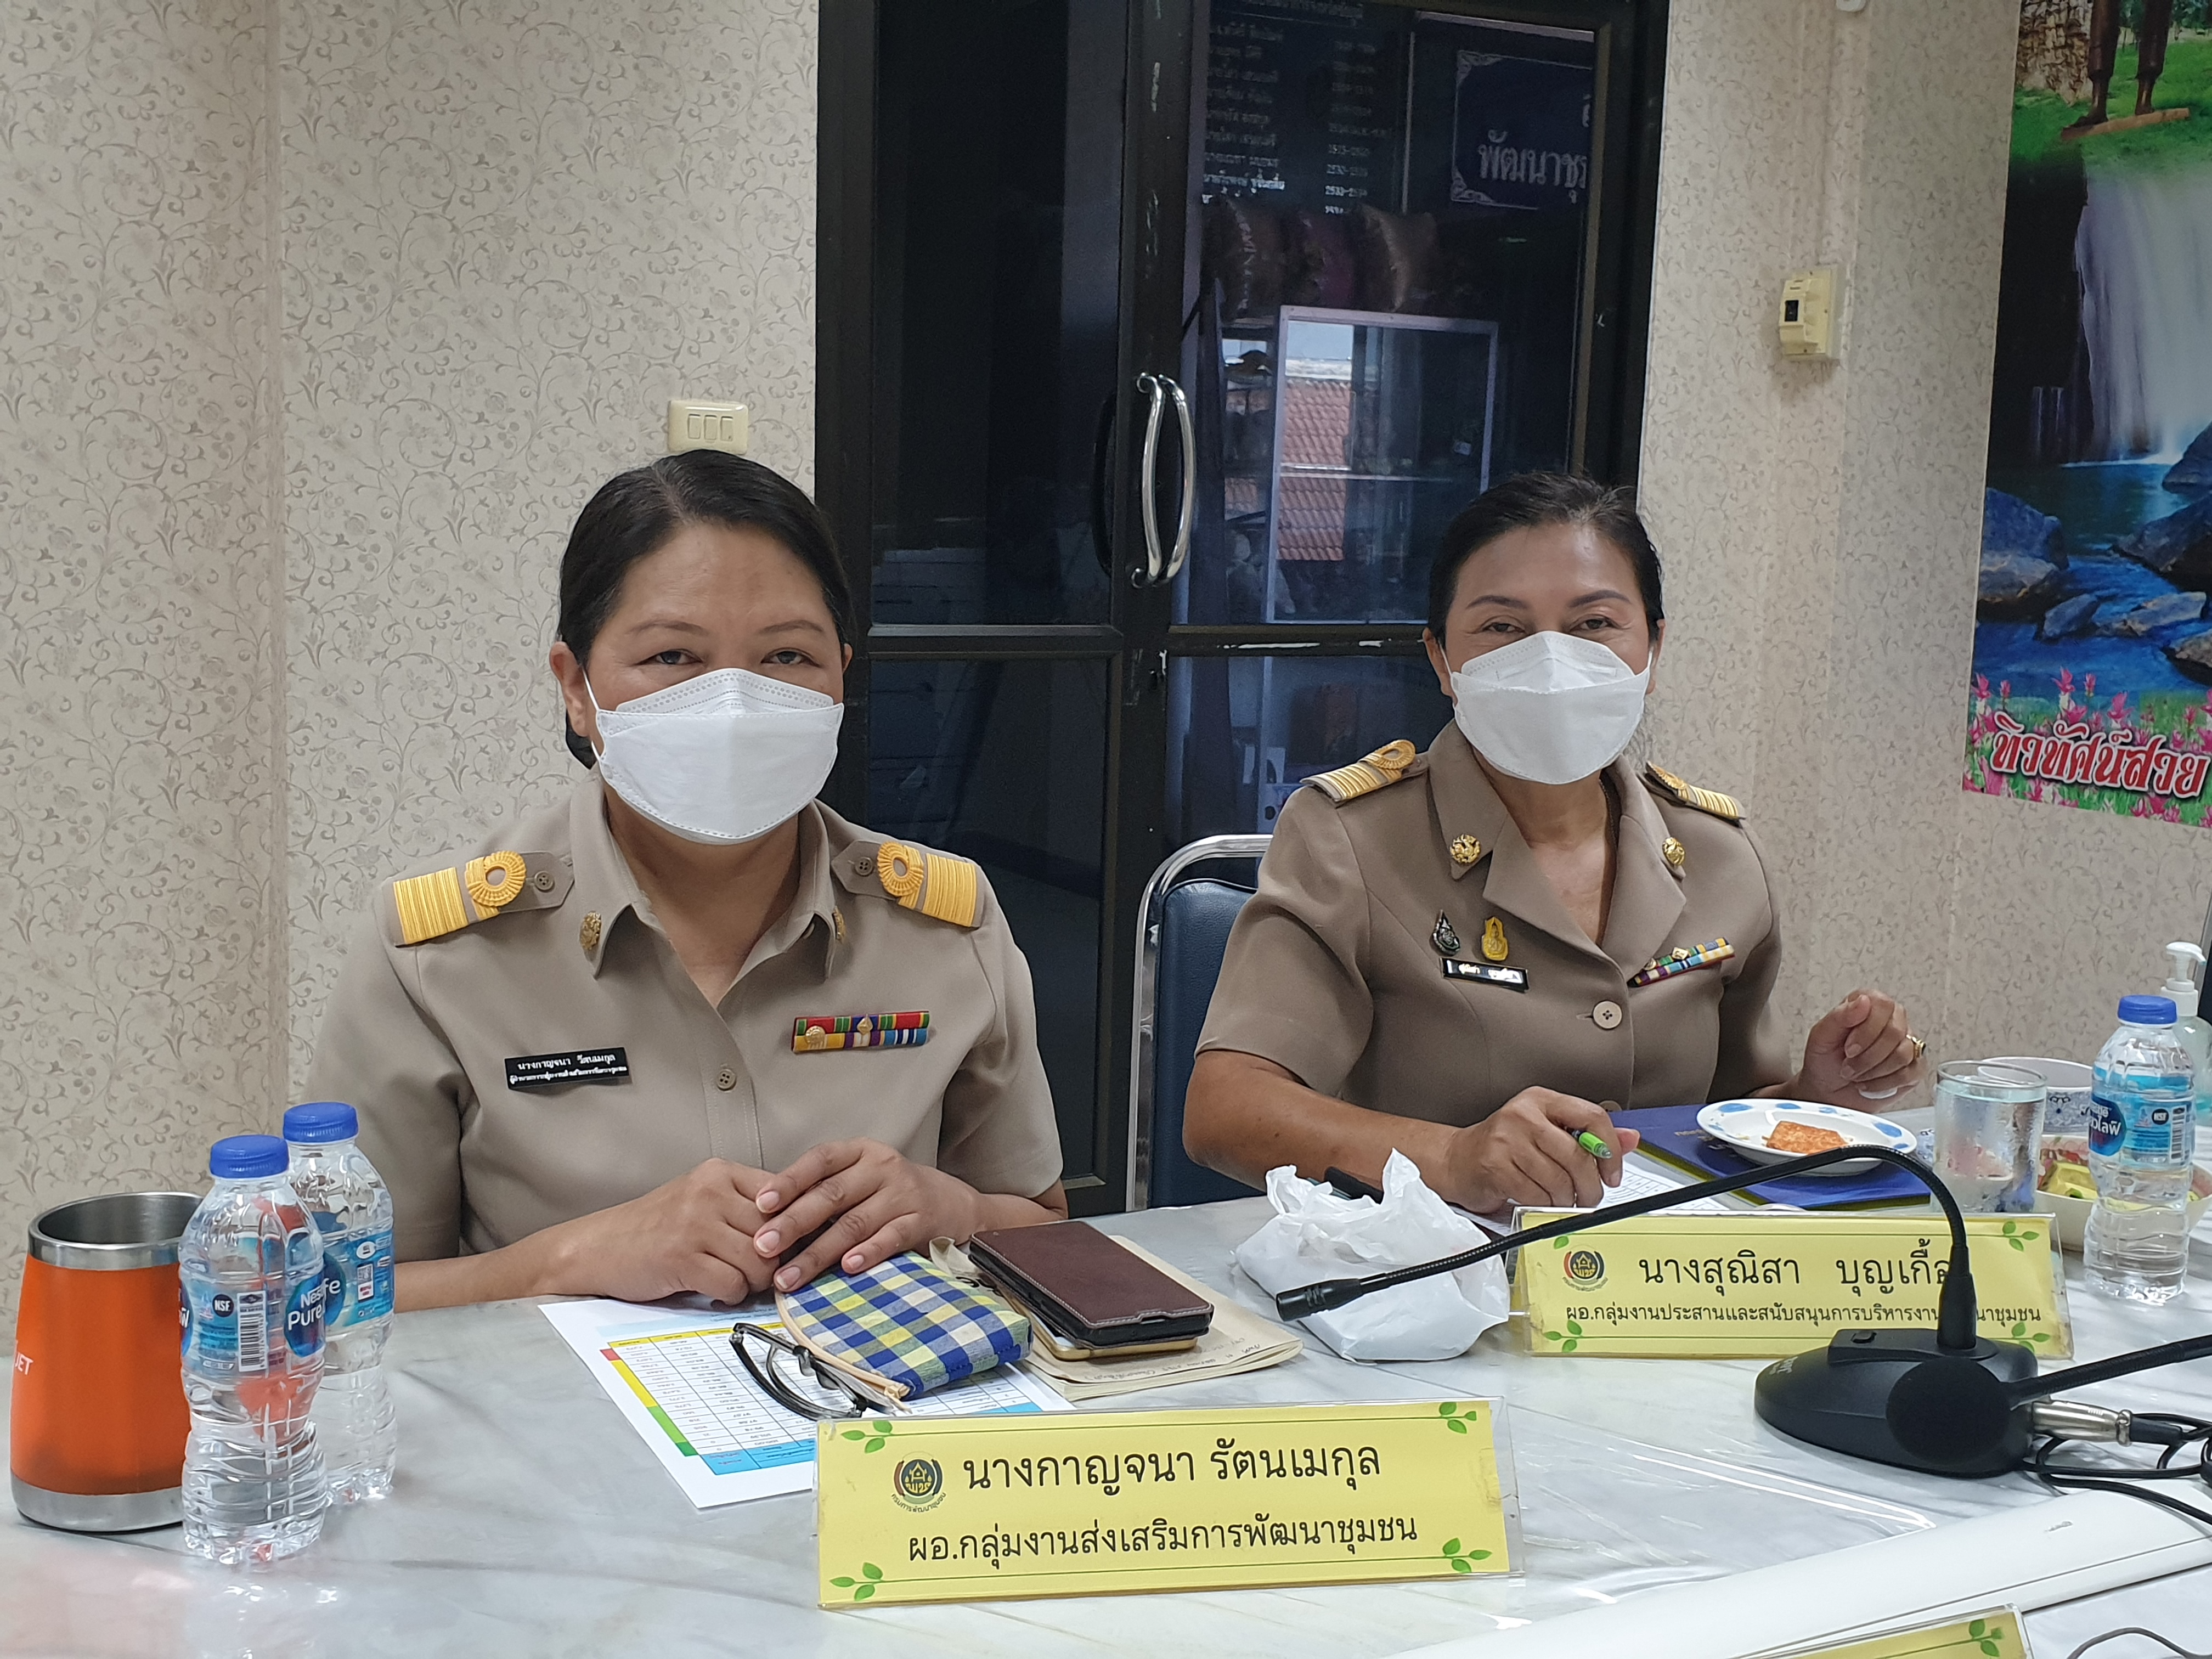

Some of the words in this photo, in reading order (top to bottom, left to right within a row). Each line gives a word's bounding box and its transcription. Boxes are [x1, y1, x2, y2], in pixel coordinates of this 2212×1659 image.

[1989, 712, 2210, 797] ทิวทัศน์สวย
[1638, 1249, 1800, 1297] นางสุณิสา
[214, 1300, 231, 1312] NSF
[963, 1451, 1194, 1496] นางกาญจนา
[1210, 1437, 1381, 1491] รัตนเมกุล
[909, 1512, 1418, 1569] ผอ.กลุ่มงานส่งเสริมการพัฒนาชุมชน
